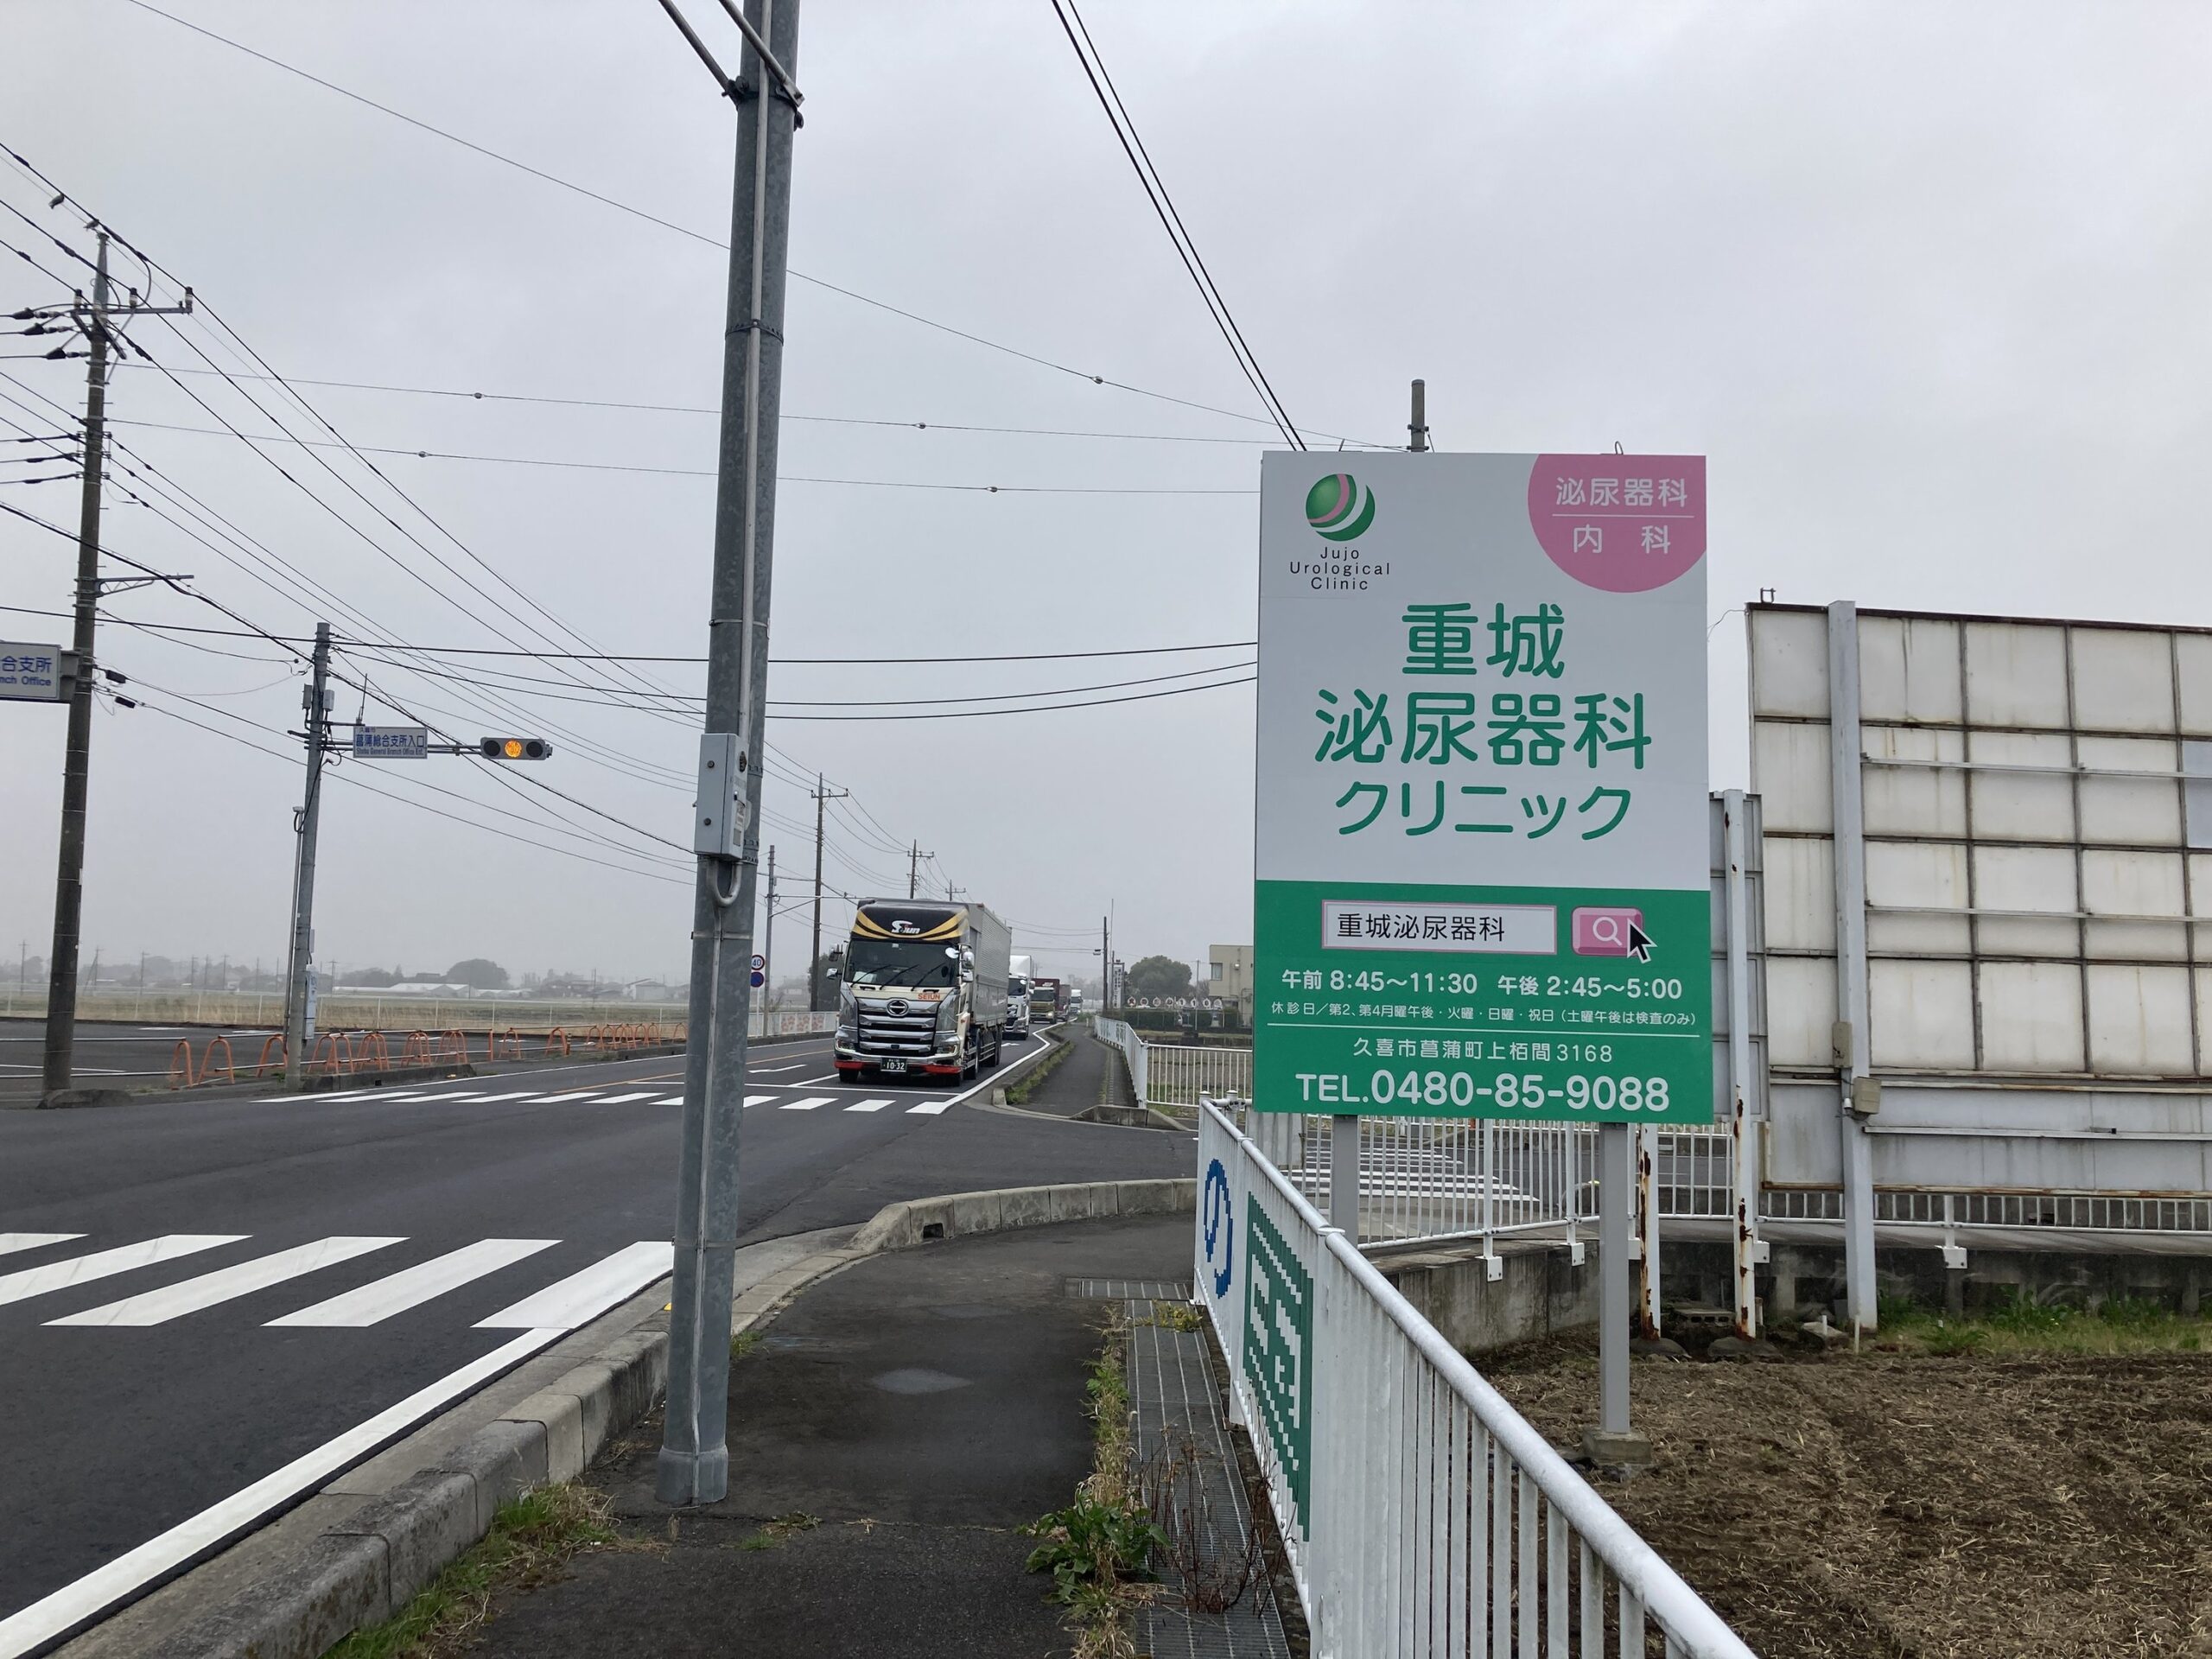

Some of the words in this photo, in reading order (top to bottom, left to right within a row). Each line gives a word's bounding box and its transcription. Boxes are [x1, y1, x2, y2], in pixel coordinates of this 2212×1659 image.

[1555, 478, 1687, 507] 泌尿器科
[1289, 561, 1390, 576] Urological
[1320, 547, 1359, 561] Jujo
[1311, 576, 1369, 590] Clinic
[1402, 602, 1566, 678] 重城
[22, 676, 52, 686] Office
[1315, 689, 1652, 769] 泌尿器科
[1336, 780, 1630, 840] クリニック
[1337, 912, 1505, 942] 重城泌尿器科
[1281, 969, 1322, 991] 午前
[1497, 975, 1539, 996] 午後
[1295, 1069, 1670, 1112] TEL.0480-85-9088
